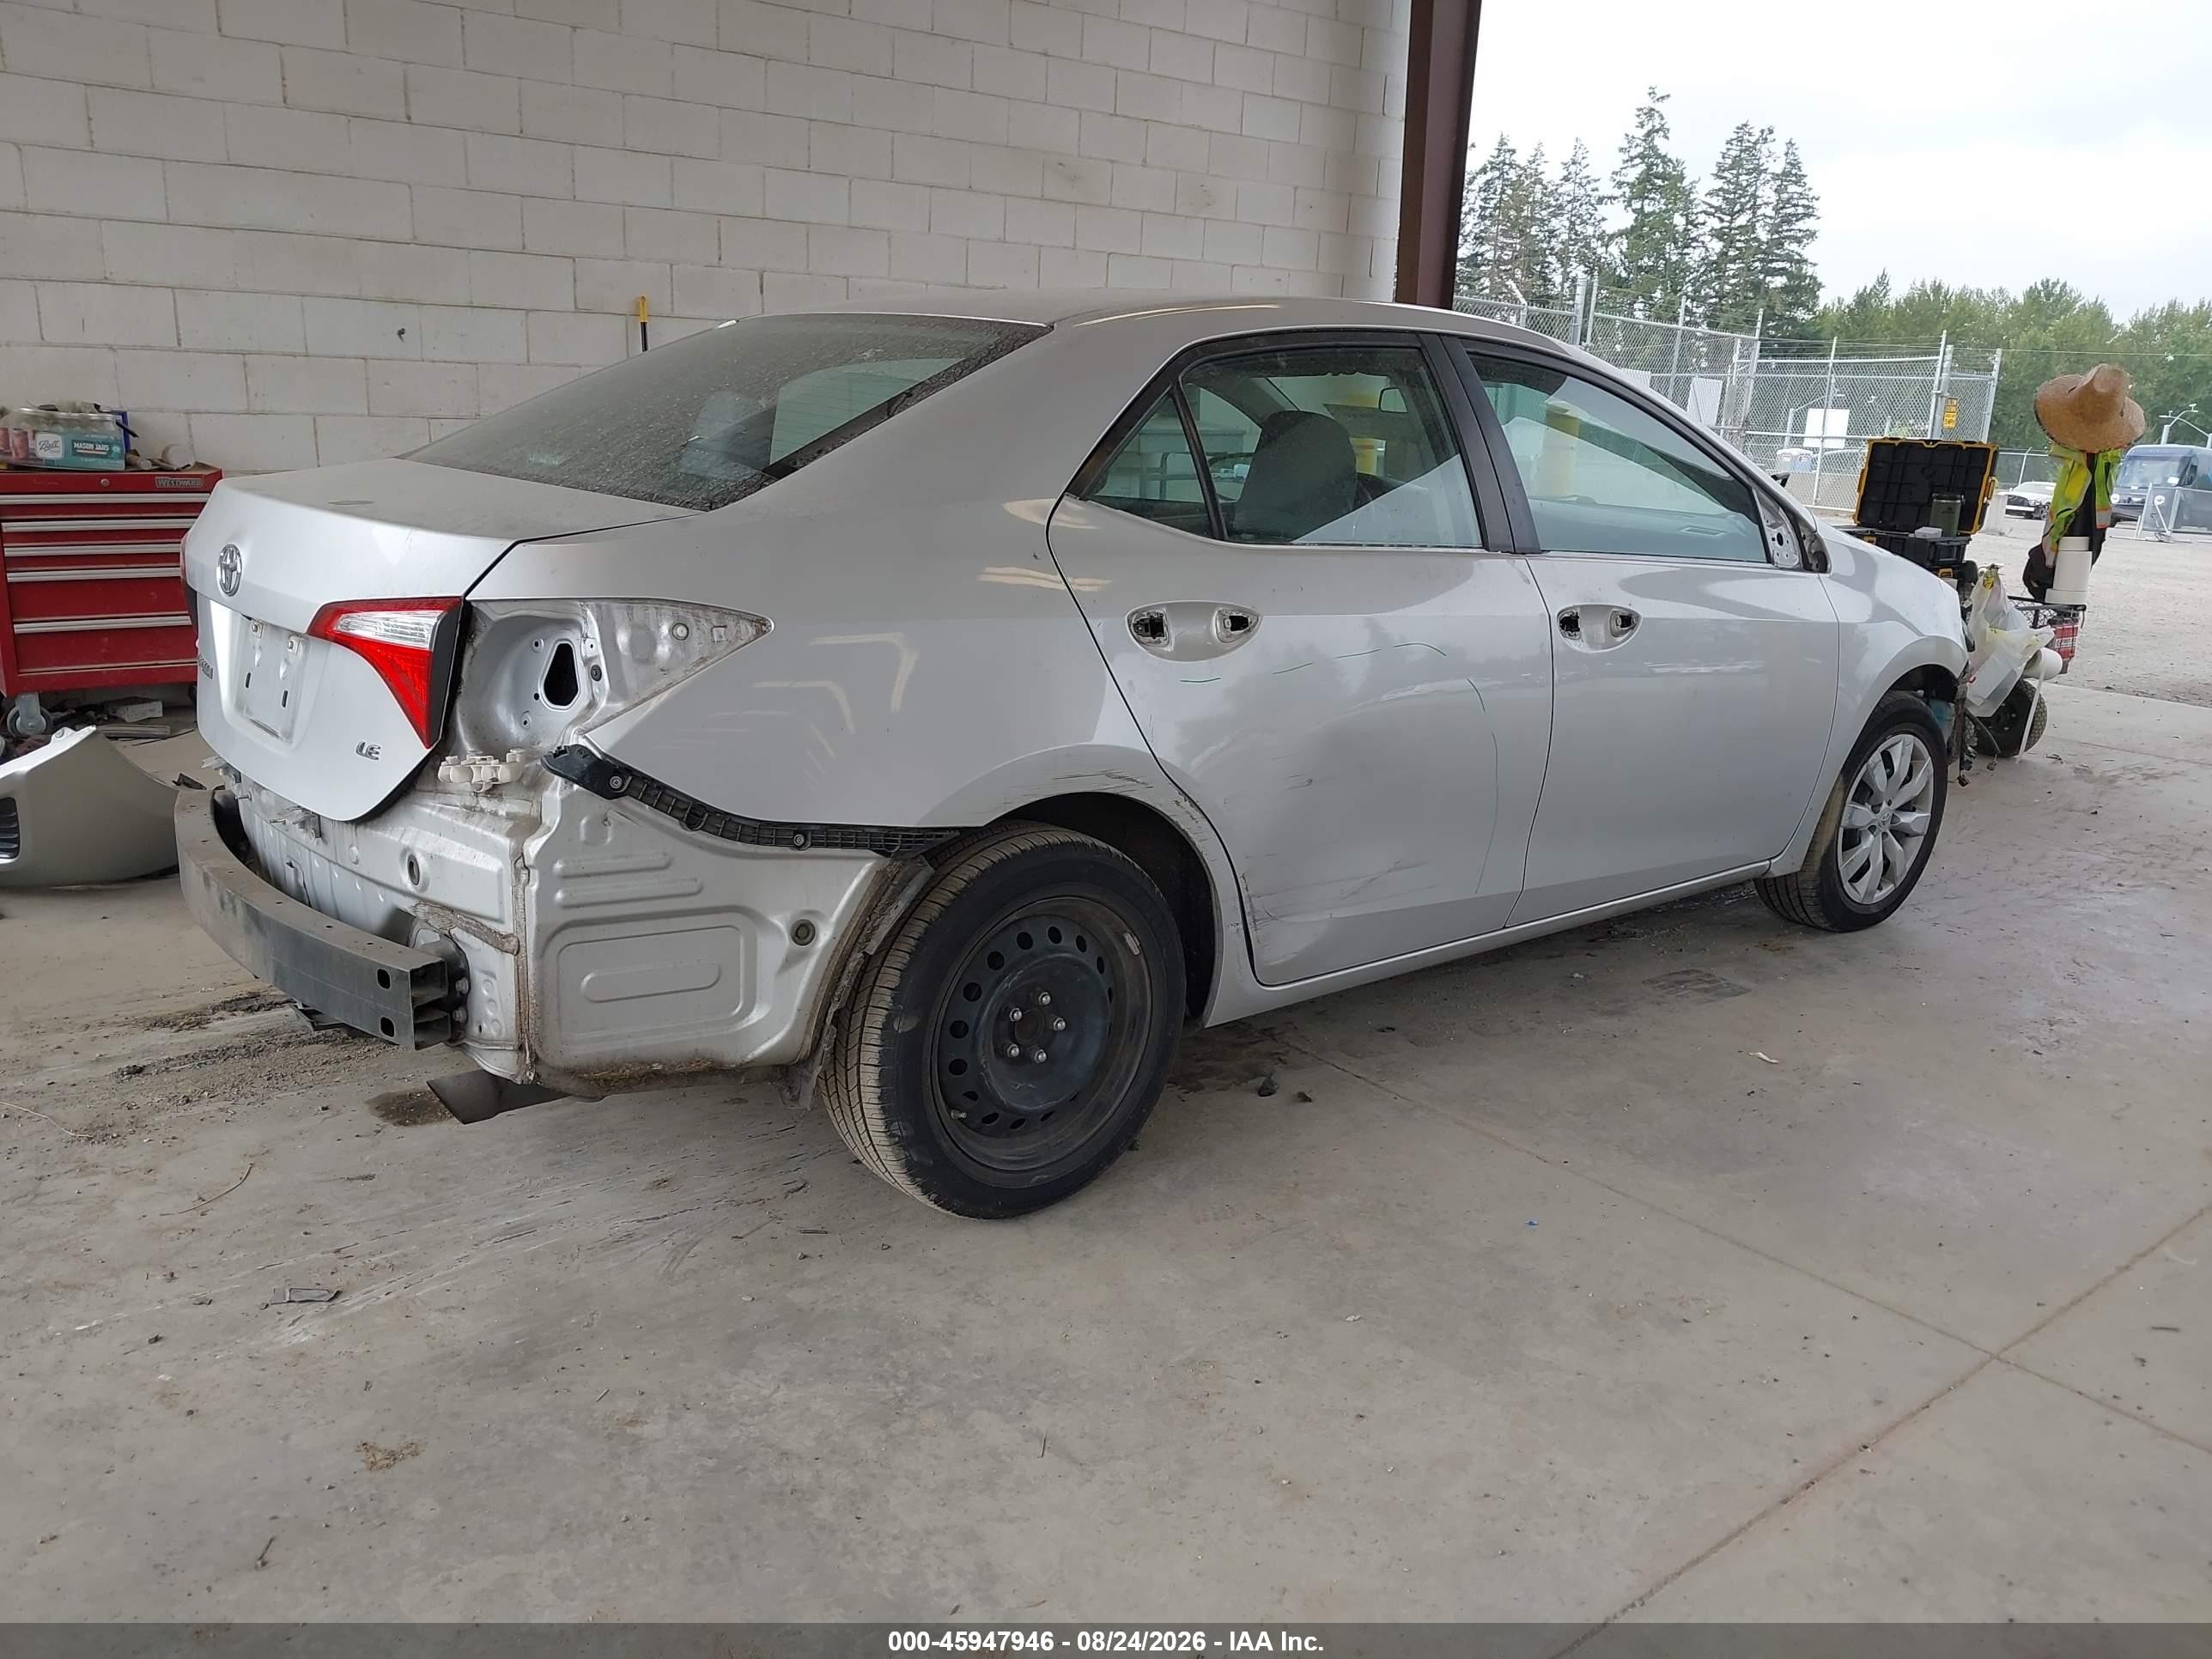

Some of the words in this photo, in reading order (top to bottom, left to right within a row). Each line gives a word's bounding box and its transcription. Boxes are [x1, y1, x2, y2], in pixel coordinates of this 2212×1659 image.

[39, 440, 60, 452] Ball
[74, 441, 94, 450] MASON
[356, 740, 381, 761] LE
